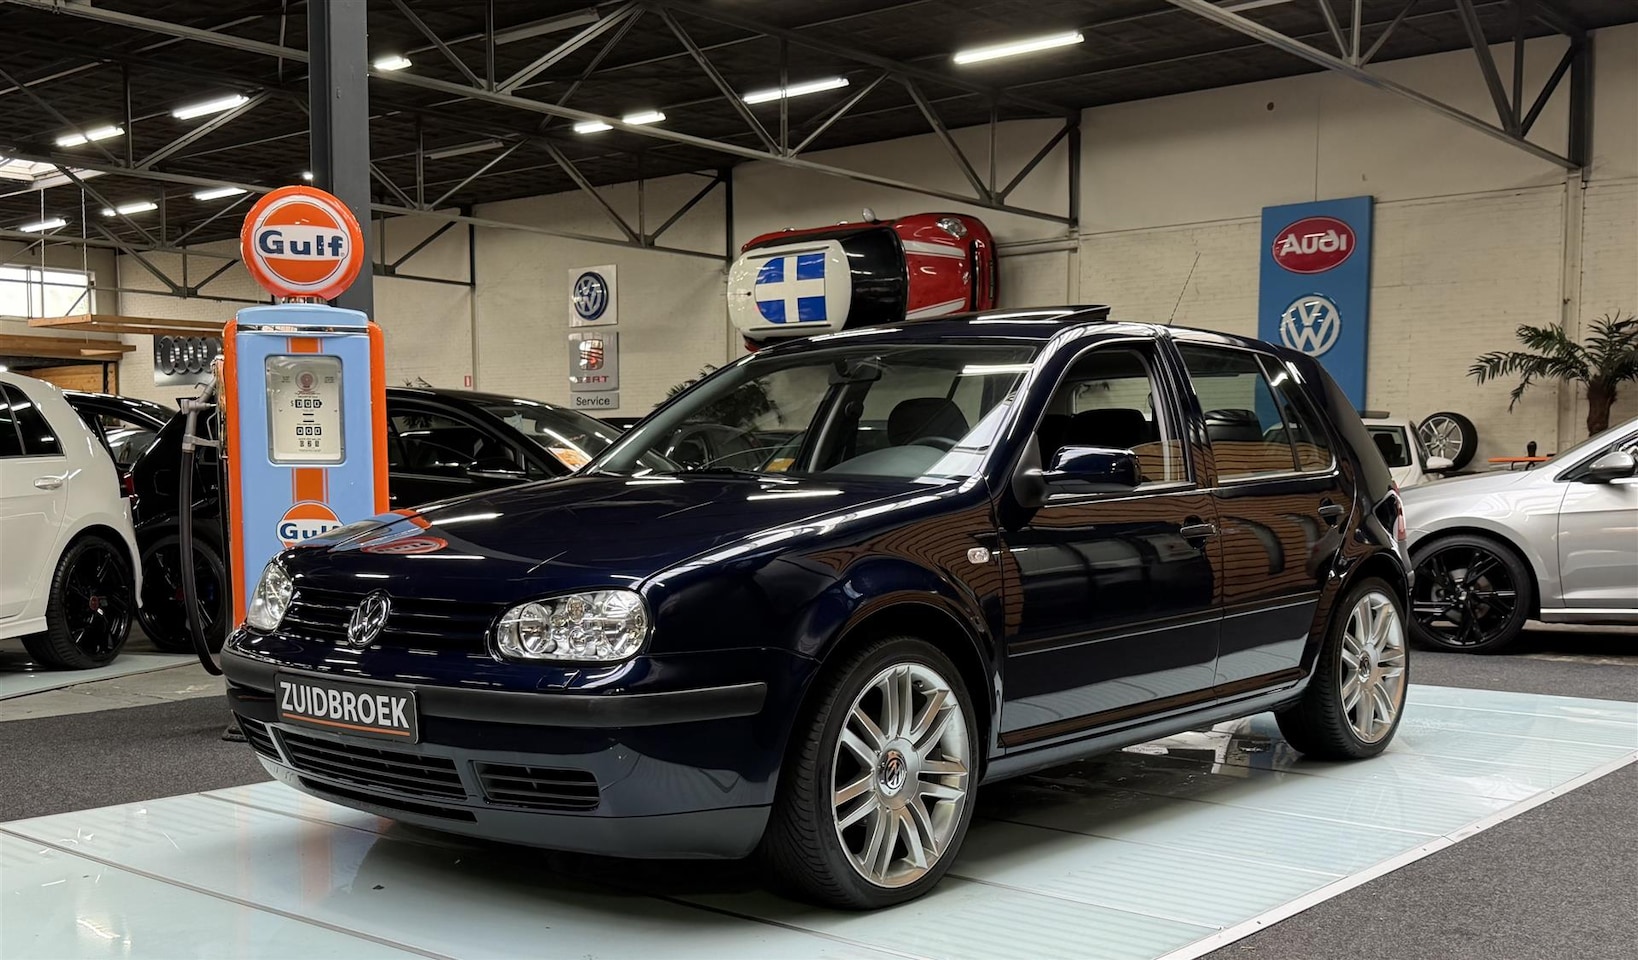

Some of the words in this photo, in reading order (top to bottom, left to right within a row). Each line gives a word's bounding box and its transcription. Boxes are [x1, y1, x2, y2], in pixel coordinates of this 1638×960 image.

[259, 230, 343, 256] Gulf
[576, 396, 610, 406] Service
[280, 523, 341, 539] Gu
[280, 682, 410, 728] ZUIDBROEK
